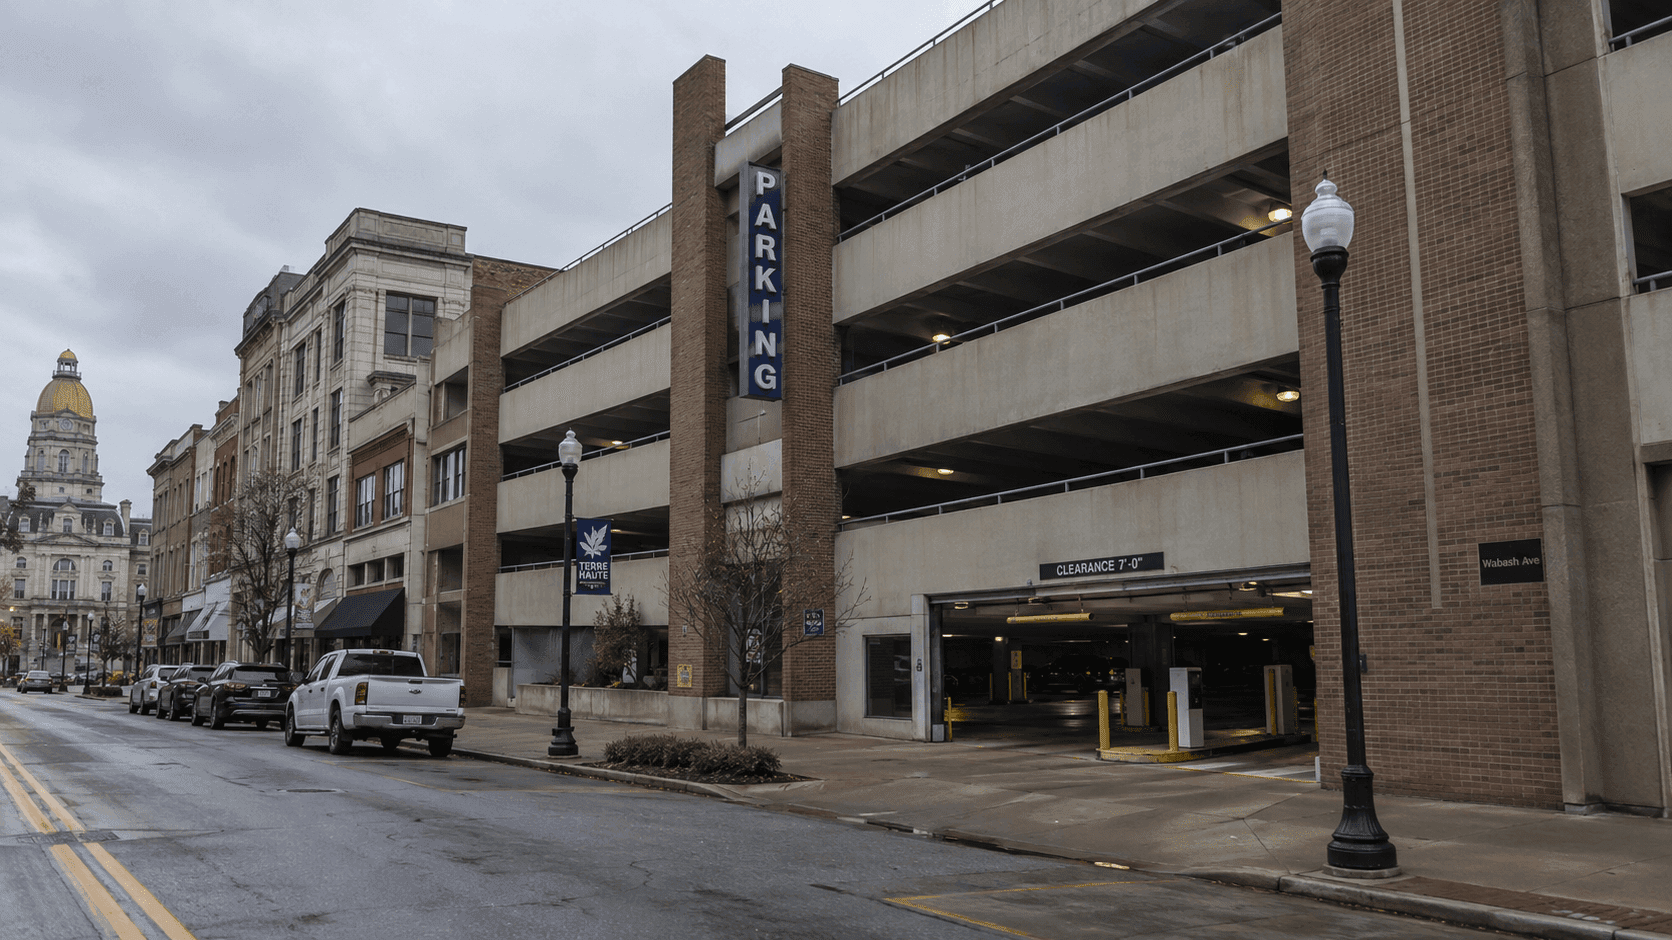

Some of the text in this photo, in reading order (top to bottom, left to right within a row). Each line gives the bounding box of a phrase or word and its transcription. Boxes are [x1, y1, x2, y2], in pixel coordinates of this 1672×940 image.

[754, 171, 777, 390] PARKING
[579, 561, 608, 571] TERRE
[1056, 560, 1115, 576] CLEARANCE
[1482, 556, 1540, 568] Wabash Ave
[579, 570, 608, 580] HAUTE
